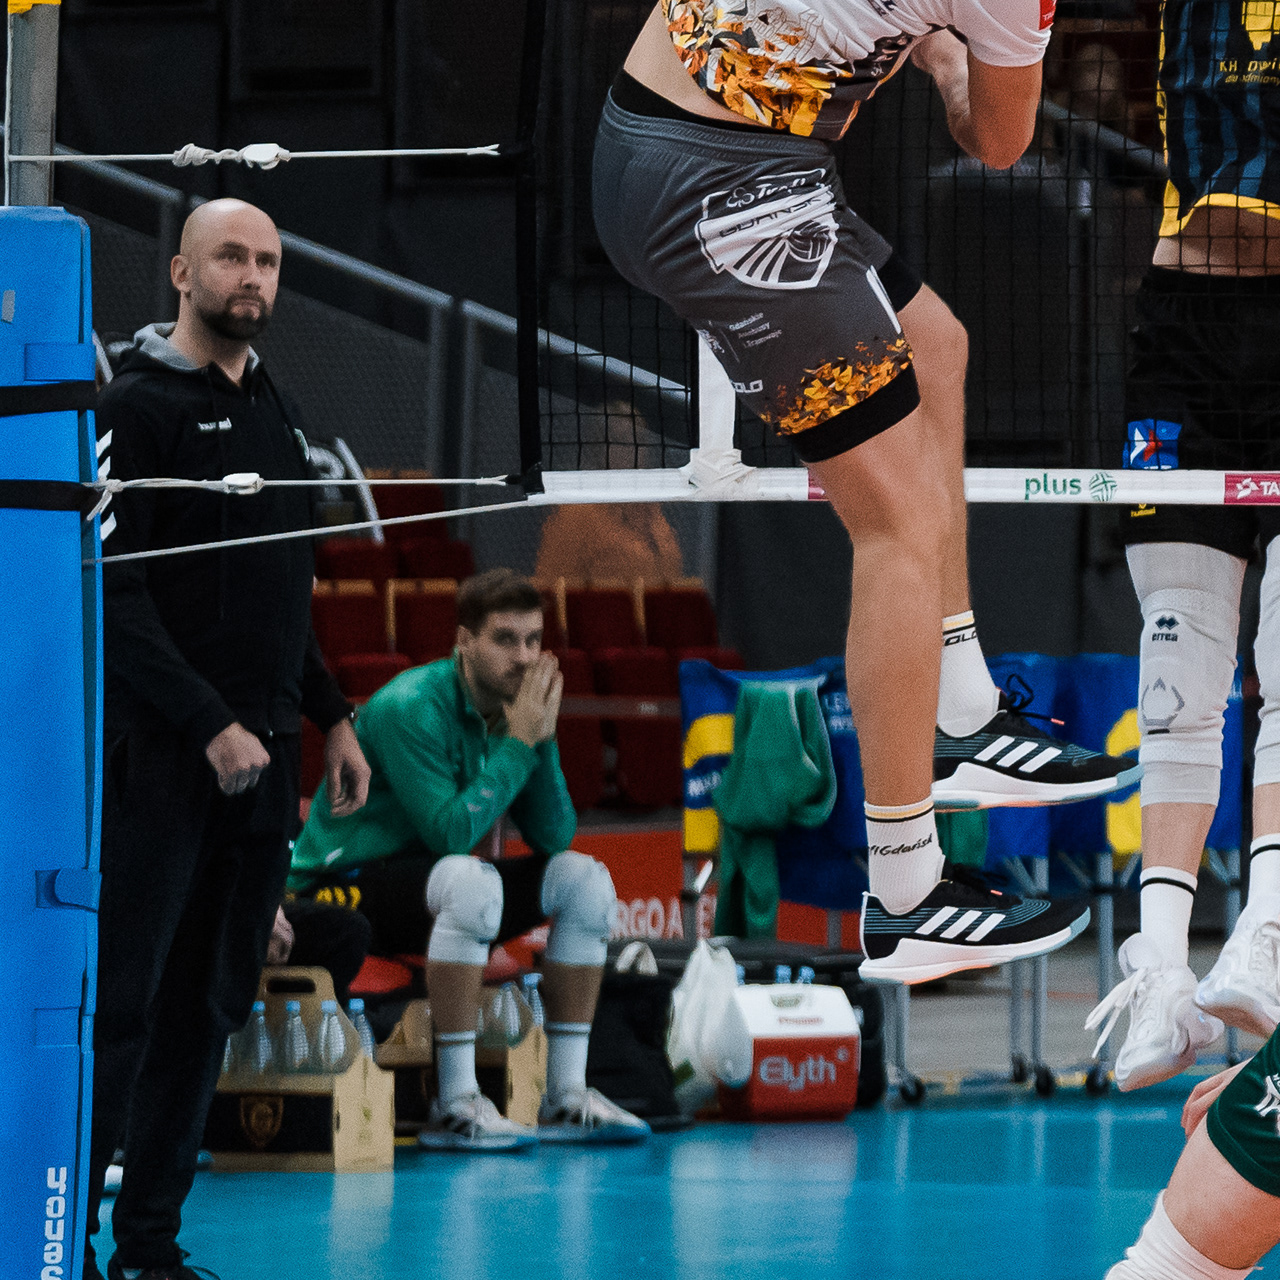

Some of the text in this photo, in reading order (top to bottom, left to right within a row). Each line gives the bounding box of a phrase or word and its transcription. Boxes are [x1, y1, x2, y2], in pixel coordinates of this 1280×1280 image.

[730, 379, 763, 393] OLO
[1025, 473, 1082, 500] plus
[944, 630, 977, 647] OLO
